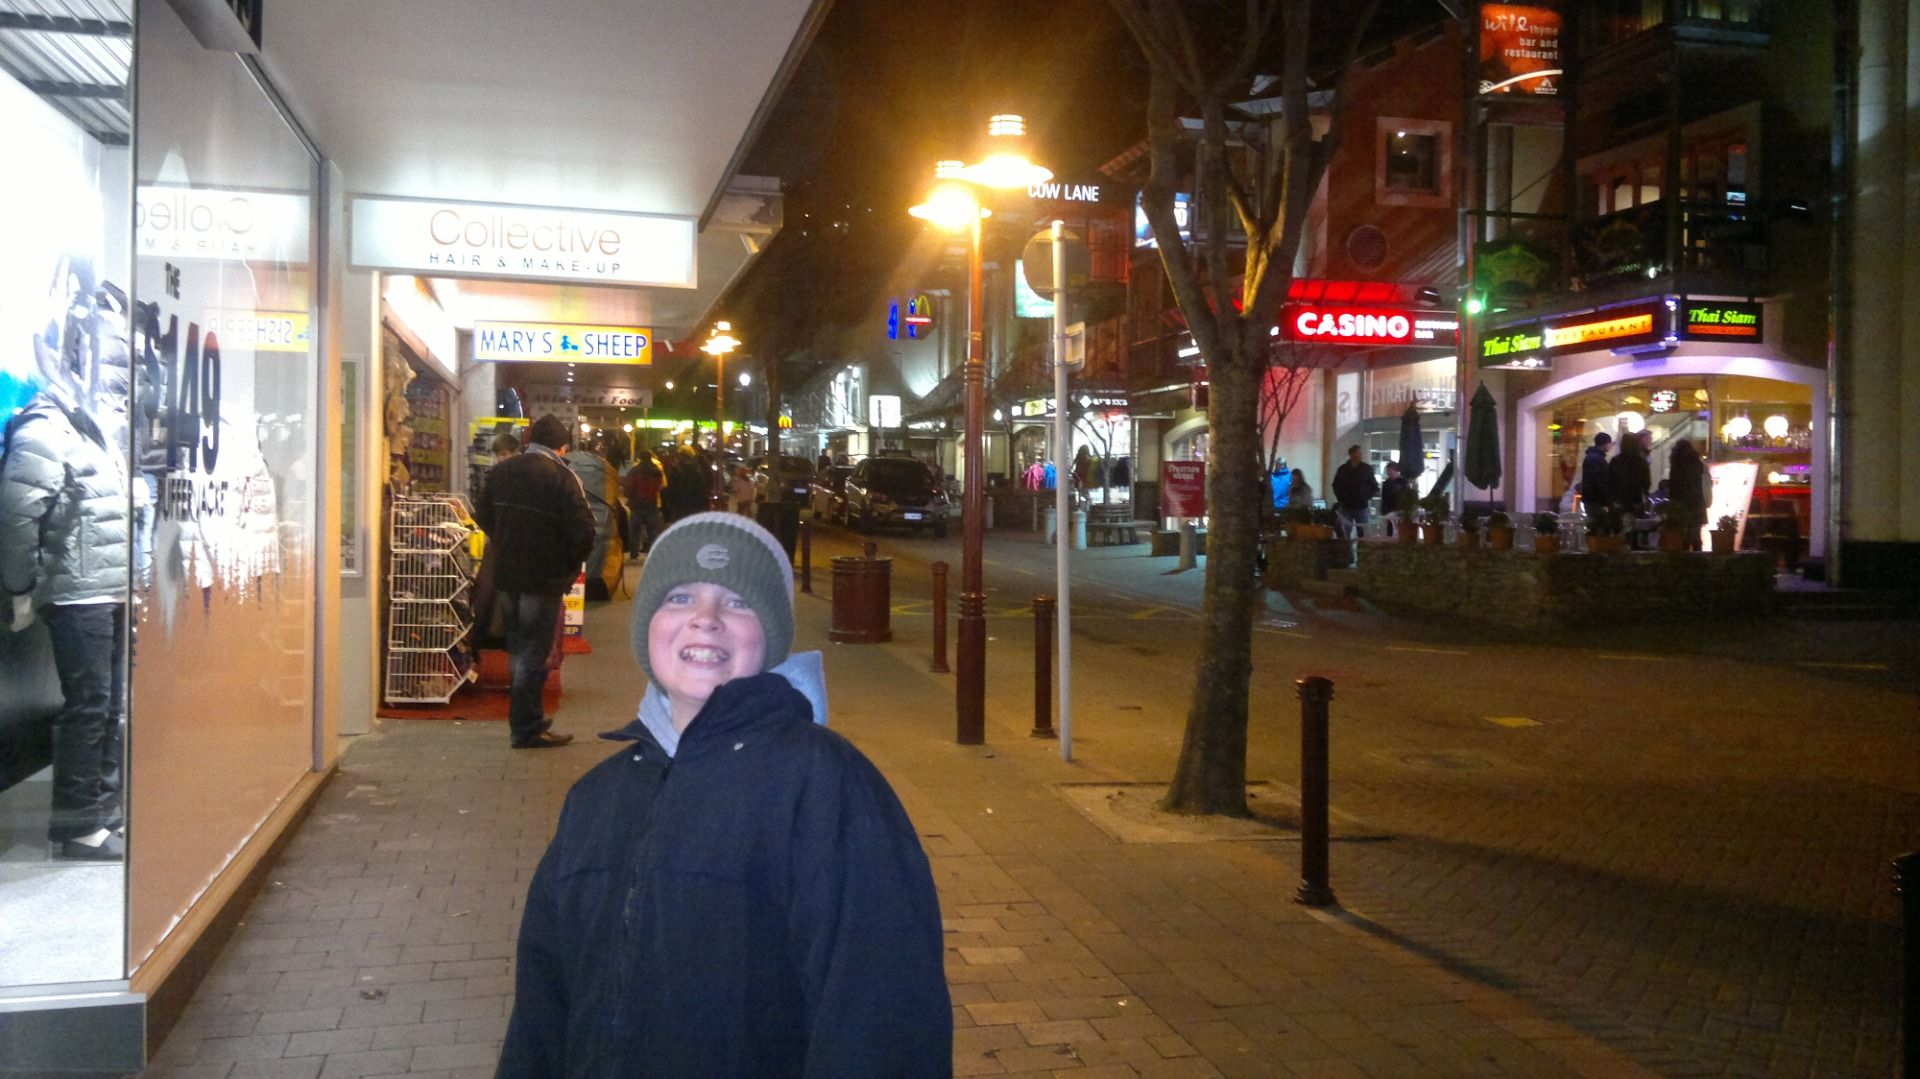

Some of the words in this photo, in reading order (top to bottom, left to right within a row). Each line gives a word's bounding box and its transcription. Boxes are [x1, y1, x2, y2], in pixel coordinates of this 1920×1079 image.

[1519, 37, 1536, 47] bar
[1540, 40, 1558, 48] and
[1505, 48, 1558, 60] restaurant
[1028, 182, 1060, 199] COW
[1064, 184, 1099, 202] LANE
[430, 209, 621, 256] Collective
[429, 253, 482, 266] HAIR
[497, 256, 507, 268] &
[523, 257, 621, 273] MAKE-UP
[1297, 312, 1410, 338] CASINO
[1688, 308, 1720, 323] Thai
[1721, 310, 1757, 325] Siam
[585, 334, 647, 357] SHEEP
[1484, 336, 1511, 357] Thai
[1509, 334, 1541, 352] Siam
[611, 396, 643, 406] Food
